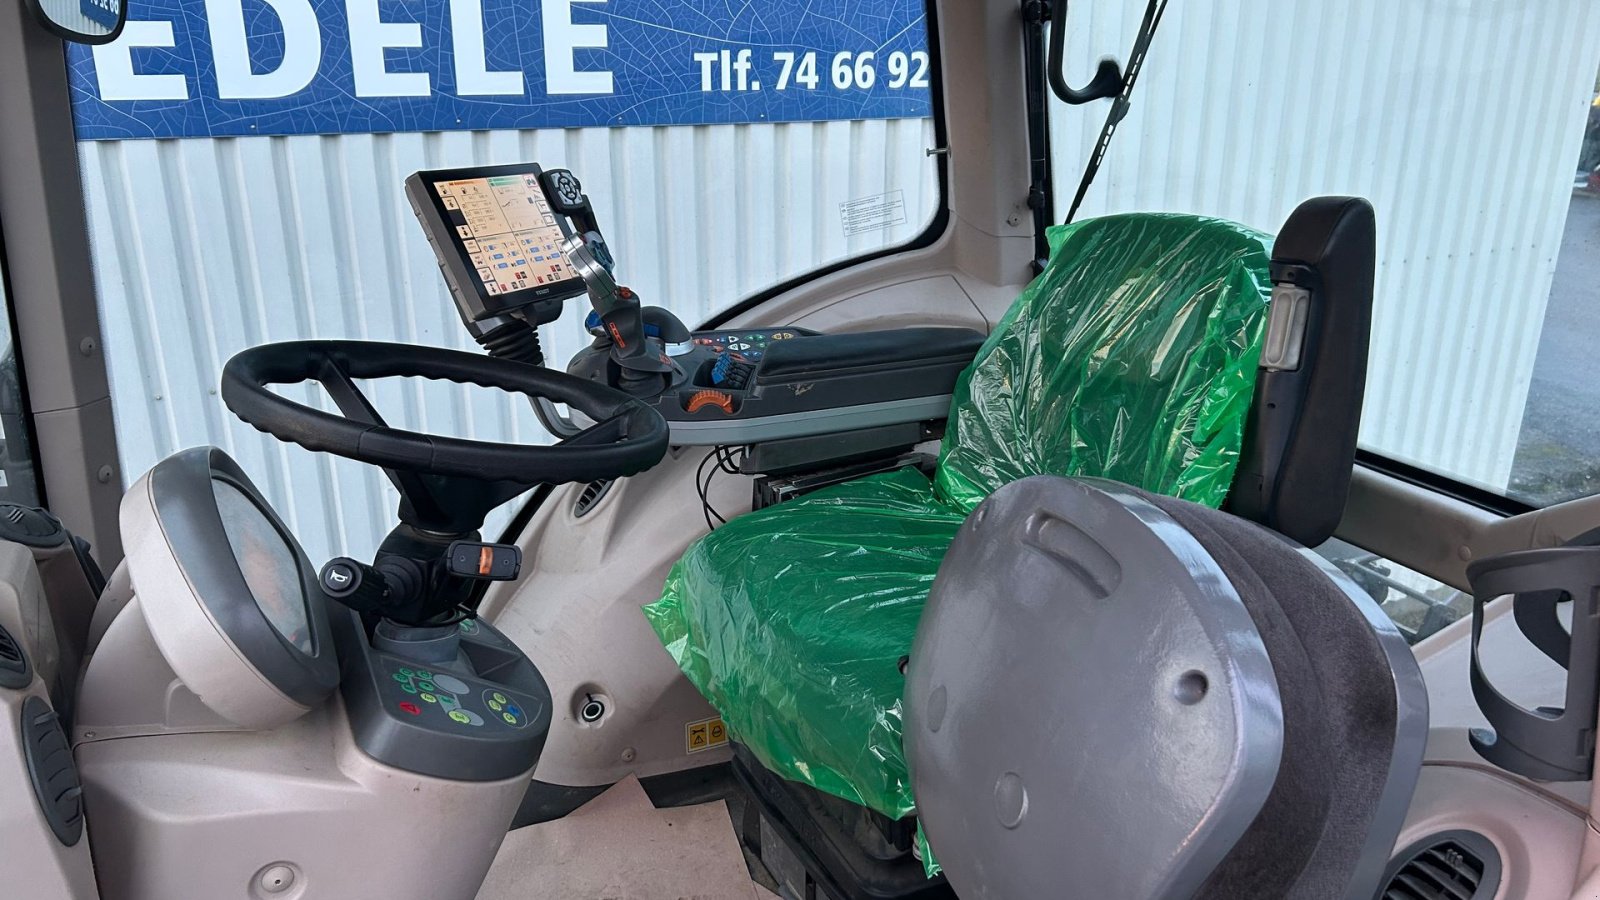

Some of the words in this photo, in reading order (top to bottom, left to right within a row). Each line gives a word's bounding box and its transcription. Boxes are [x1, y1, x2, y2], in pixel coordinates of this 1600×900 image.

[694, 49, 761, 92] Tlf.
[773, 51, 819, 91] 74
[831, 50, 876, 90] 66
[887, 50, 929, 89] 92
